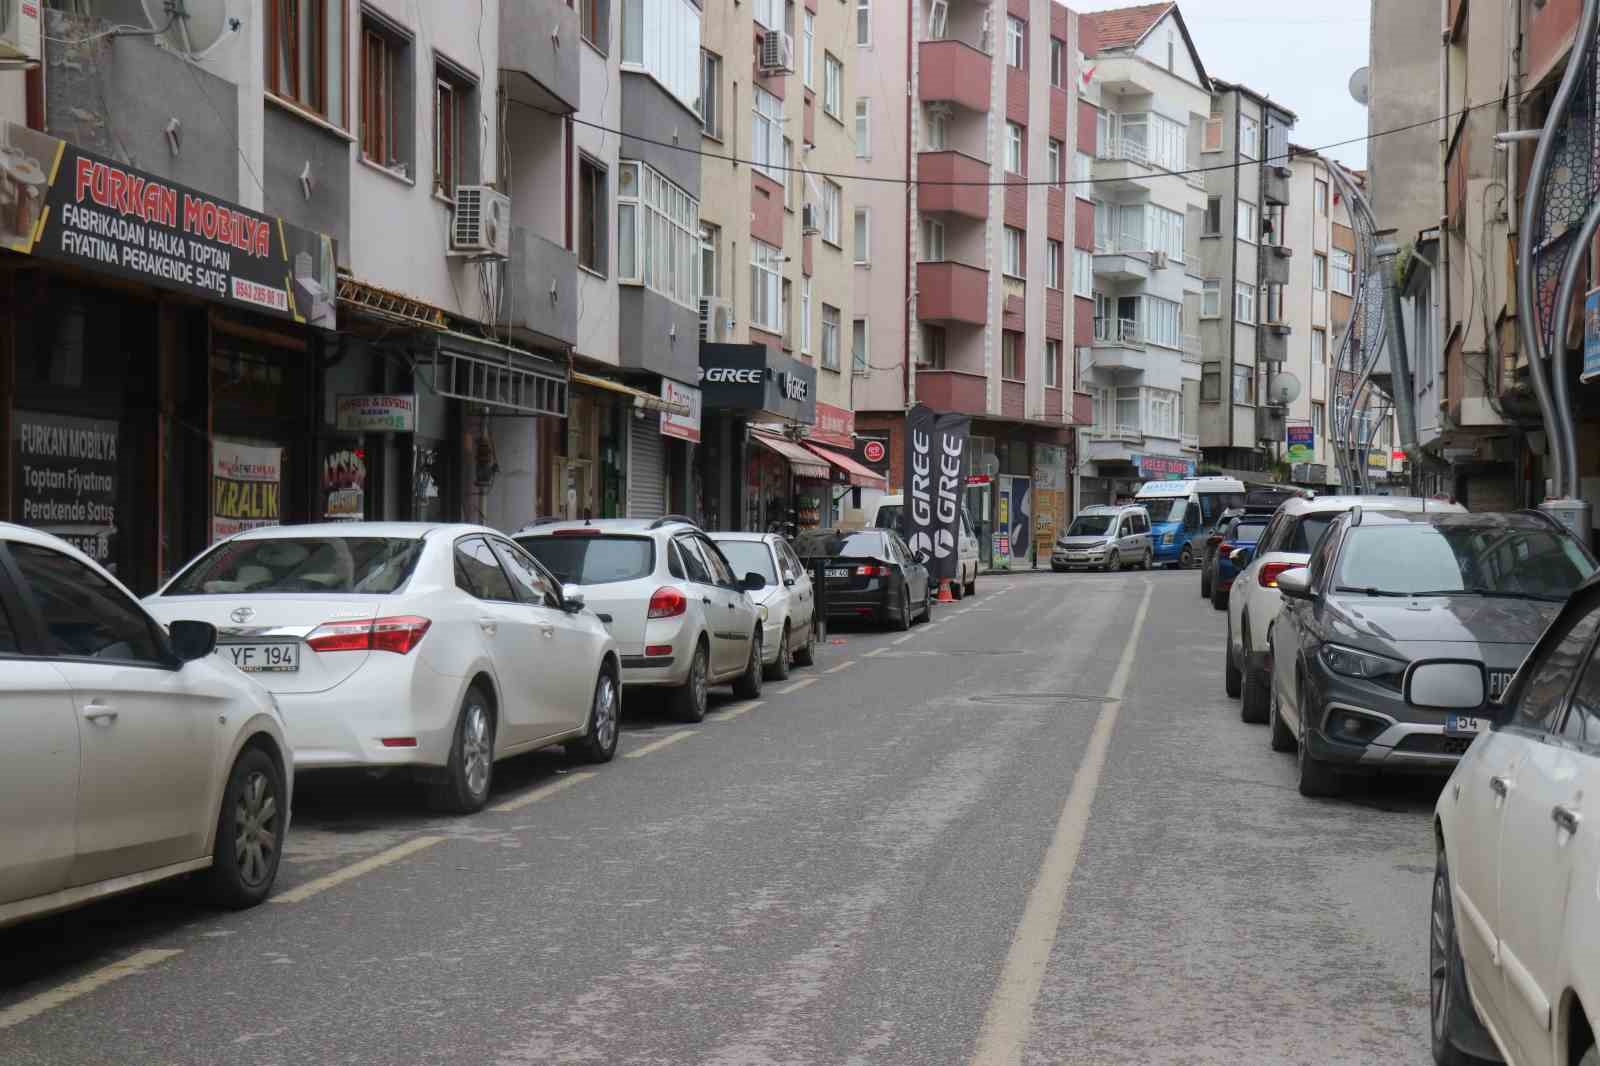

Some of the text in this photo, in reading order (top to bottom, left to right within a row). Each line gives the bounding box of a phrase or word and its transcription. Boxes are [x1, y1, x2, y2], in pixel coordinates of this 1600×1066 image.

[76, 156, 177, 228] FURKAN
[148, 229, 186, 258] HALKA
[188, 240, 231, 272] TOPTAN
[122, 249, 193, 284] PERAKENDE
[195, 267, 227, 297] SATIŞ
[705, 368, 763, 384] GREE
[791, 376, 807, 402] GREE
[20, 423, 117, 461] FURKAN MOBİLYA
[24, 465, 112, 497] Toptan Fiyatına
[912, 428, 931, 527] GREE
[936, 432, 963, 524] GREE
[24, 498, 114, 528] Perakende Satış
[231, 647, 291, 665] YF 194
